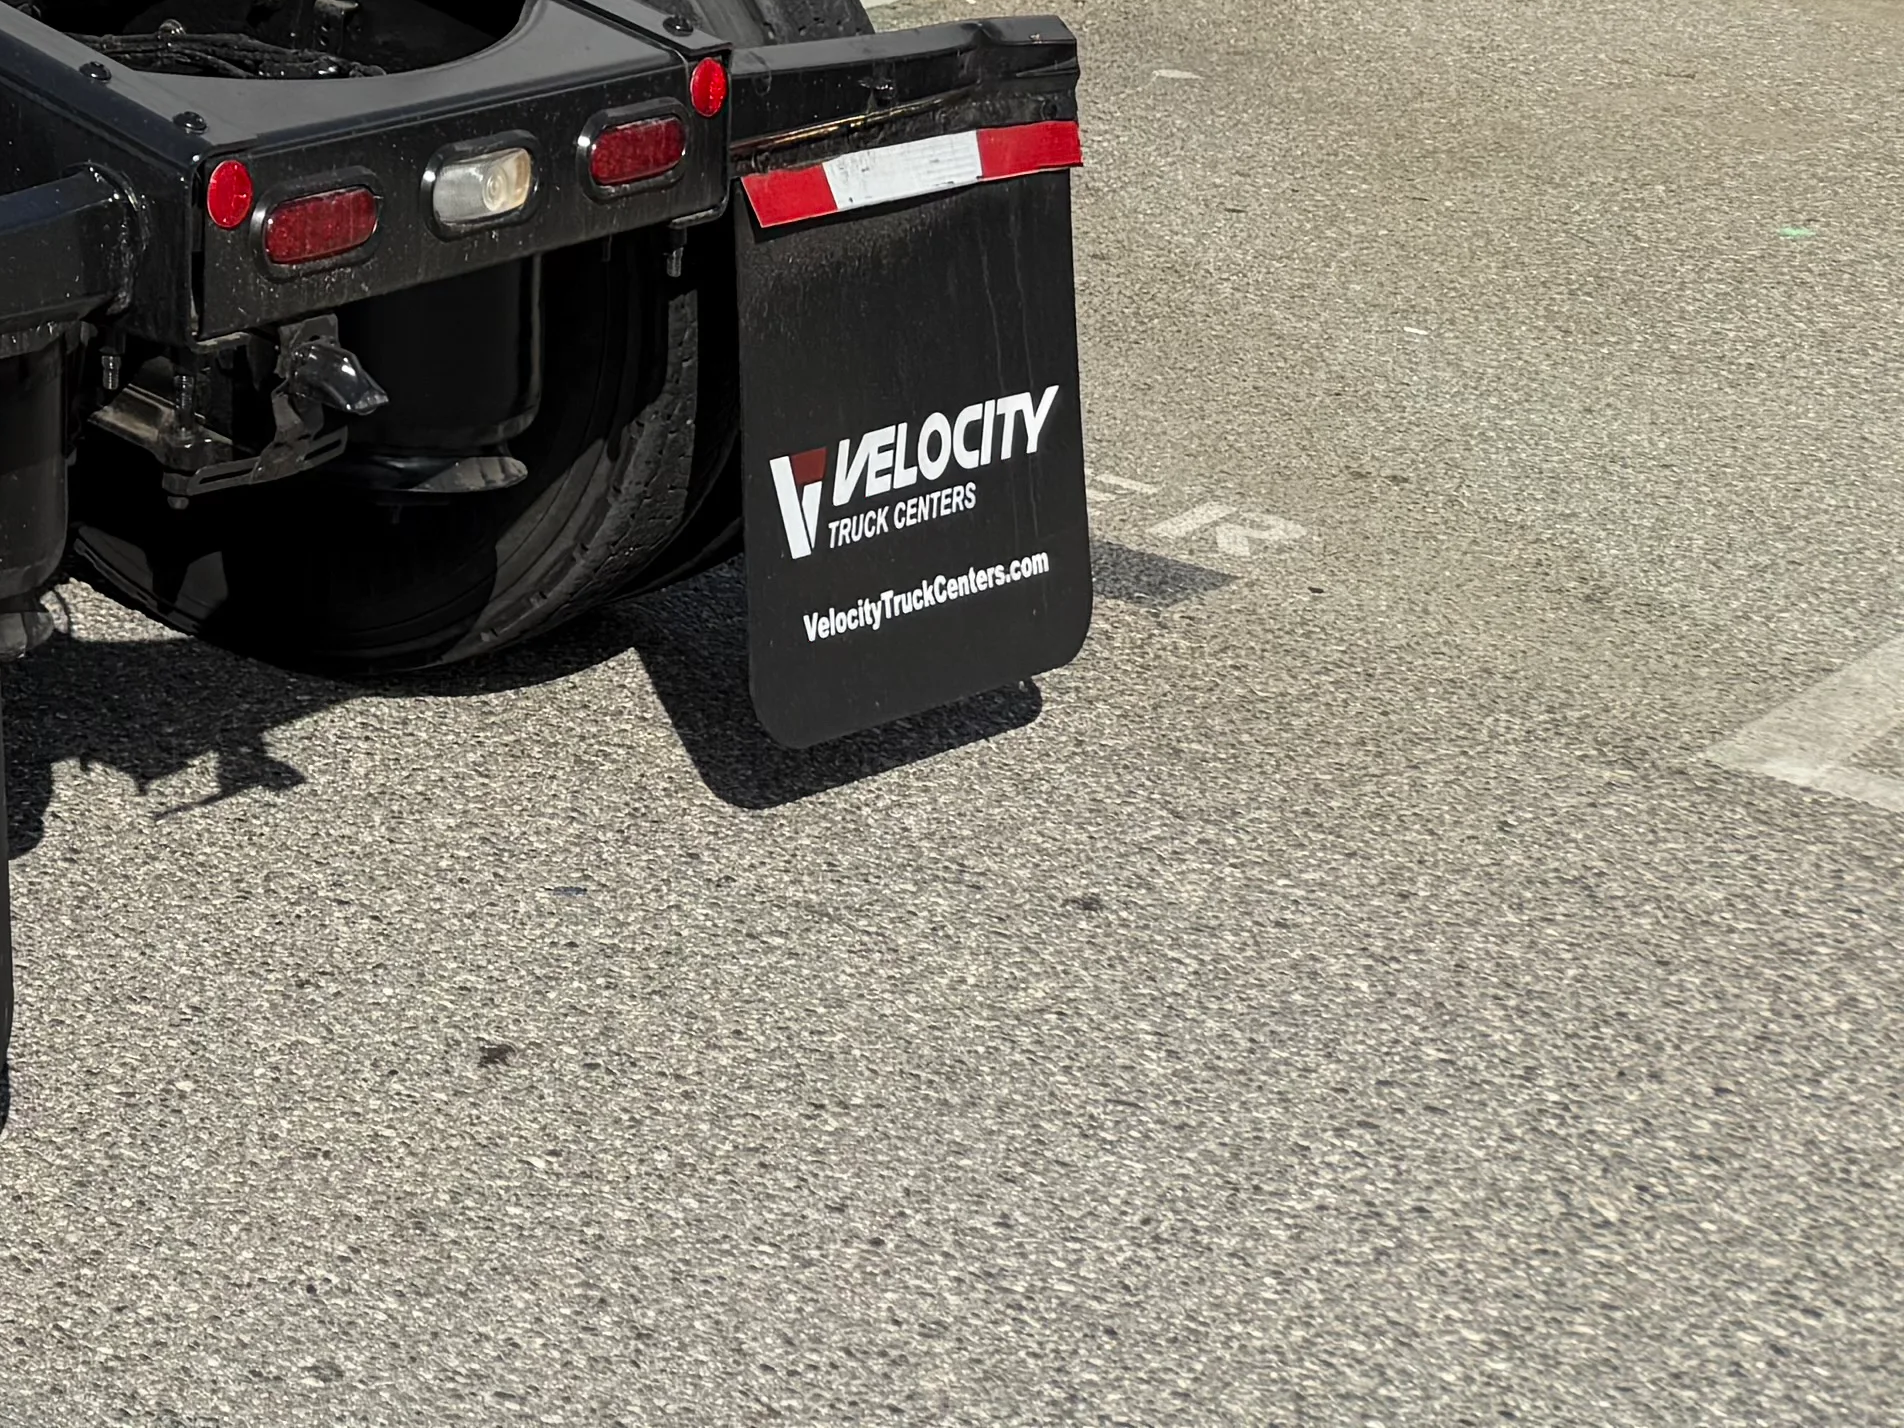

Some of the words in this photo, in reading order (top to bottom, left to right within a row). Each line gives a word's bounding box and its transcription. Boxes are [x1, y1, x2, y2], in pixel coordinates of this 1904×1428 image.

[833, 385, 1059, 507] VELOCITY
[828, 505, 890, 549] TRUCK
[893, 481, 977, 530] CENTERS
[803, 551, 1050, 642] VelocityTruckCenters.com
